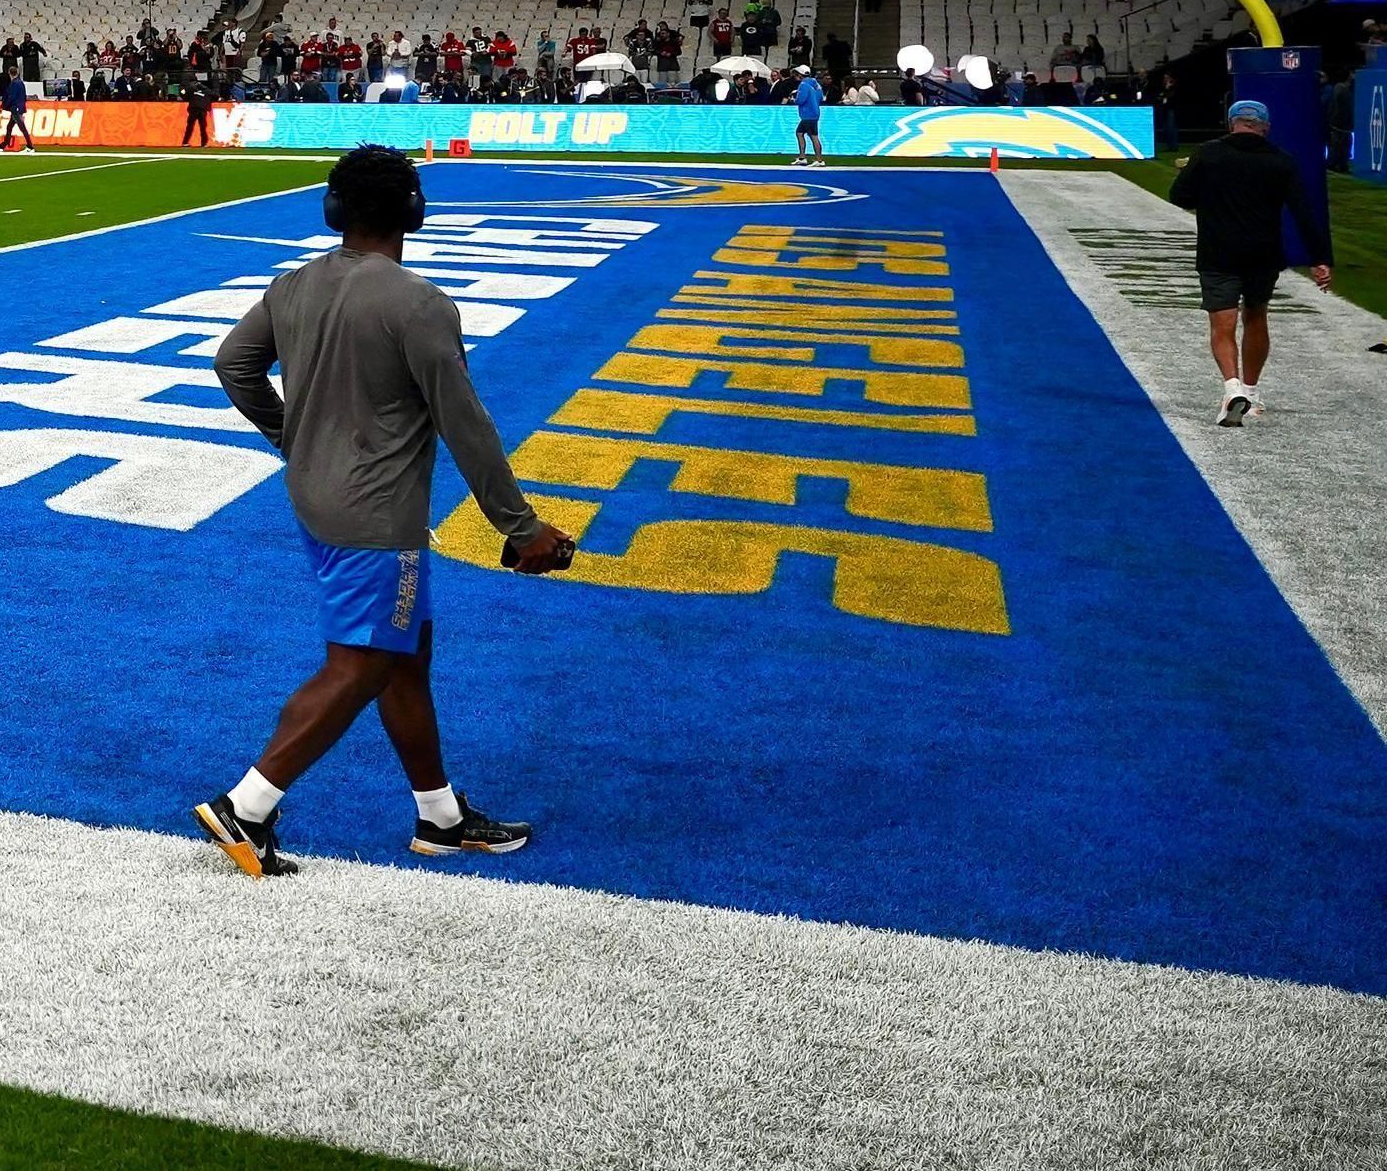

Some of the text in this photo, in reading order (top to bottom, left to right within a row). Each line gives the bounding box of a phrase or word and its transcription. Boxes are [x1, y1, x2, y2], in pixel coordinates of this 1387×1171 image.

[211, 106, 277, 143] VS
[469, 111, 568, 144] BOLT
[571, 111, 628, 144] UP
[453, 141, 465, 155] G
[432, 224, 1010, 636] LOS ANGELES
